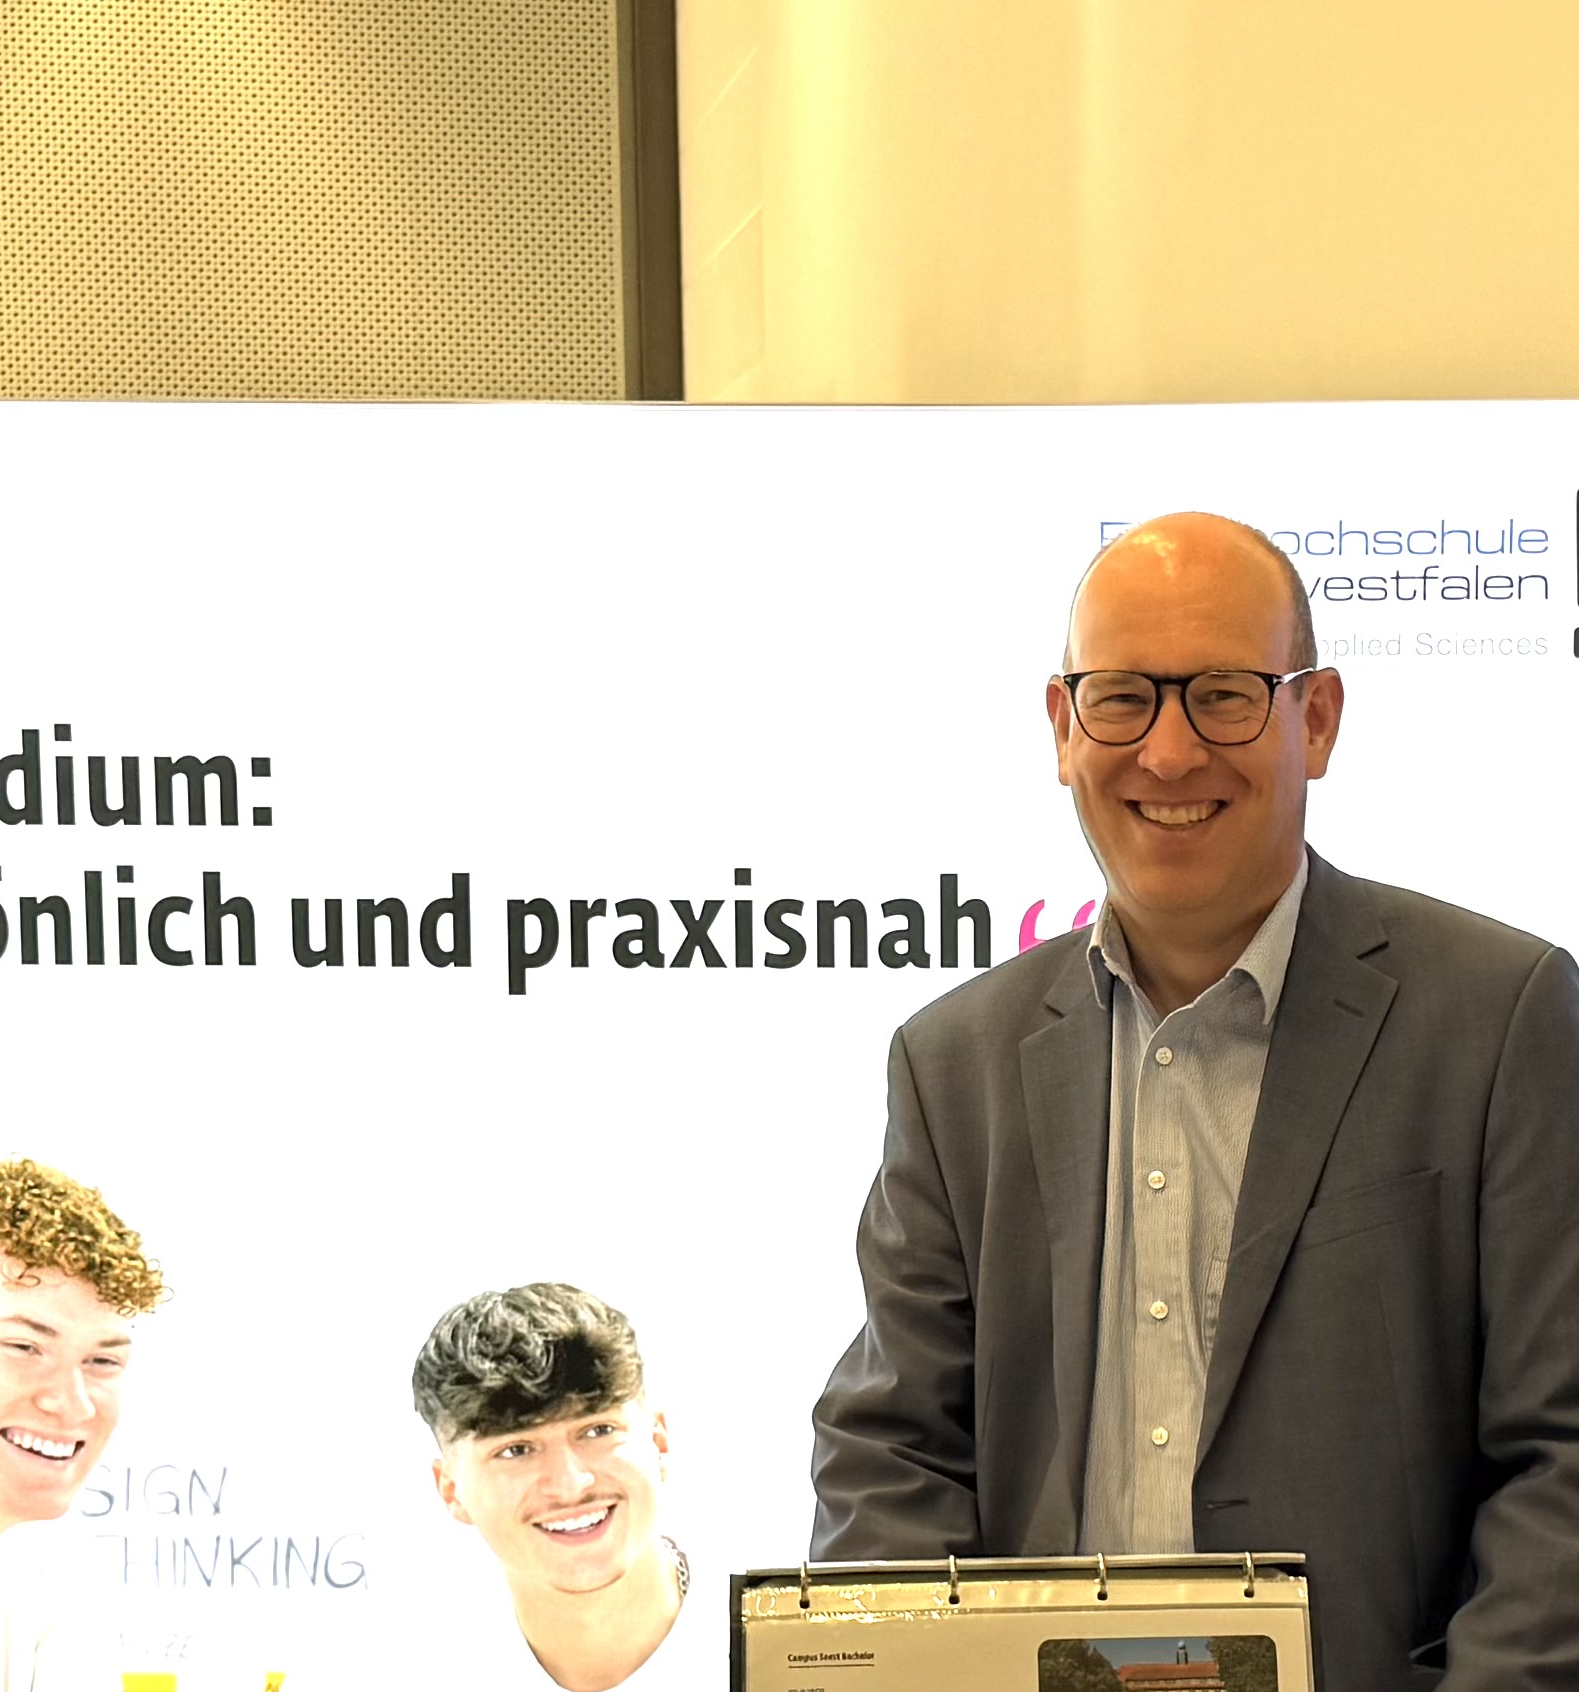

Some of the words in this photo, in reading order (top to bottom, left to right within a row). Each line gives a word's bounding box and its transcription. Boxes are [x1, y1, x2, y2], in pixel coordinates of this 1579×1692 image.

[1099, 519, 1549, 556] Fochschule
[1309, 564, 1549, 602] estfalen
[1415, 632, 1549, 657] Sciences
[291, 872, 473, 969] und
[507, 867, 993, 996] praxisnah
[80, 1464, 228, 1518] SIGN
